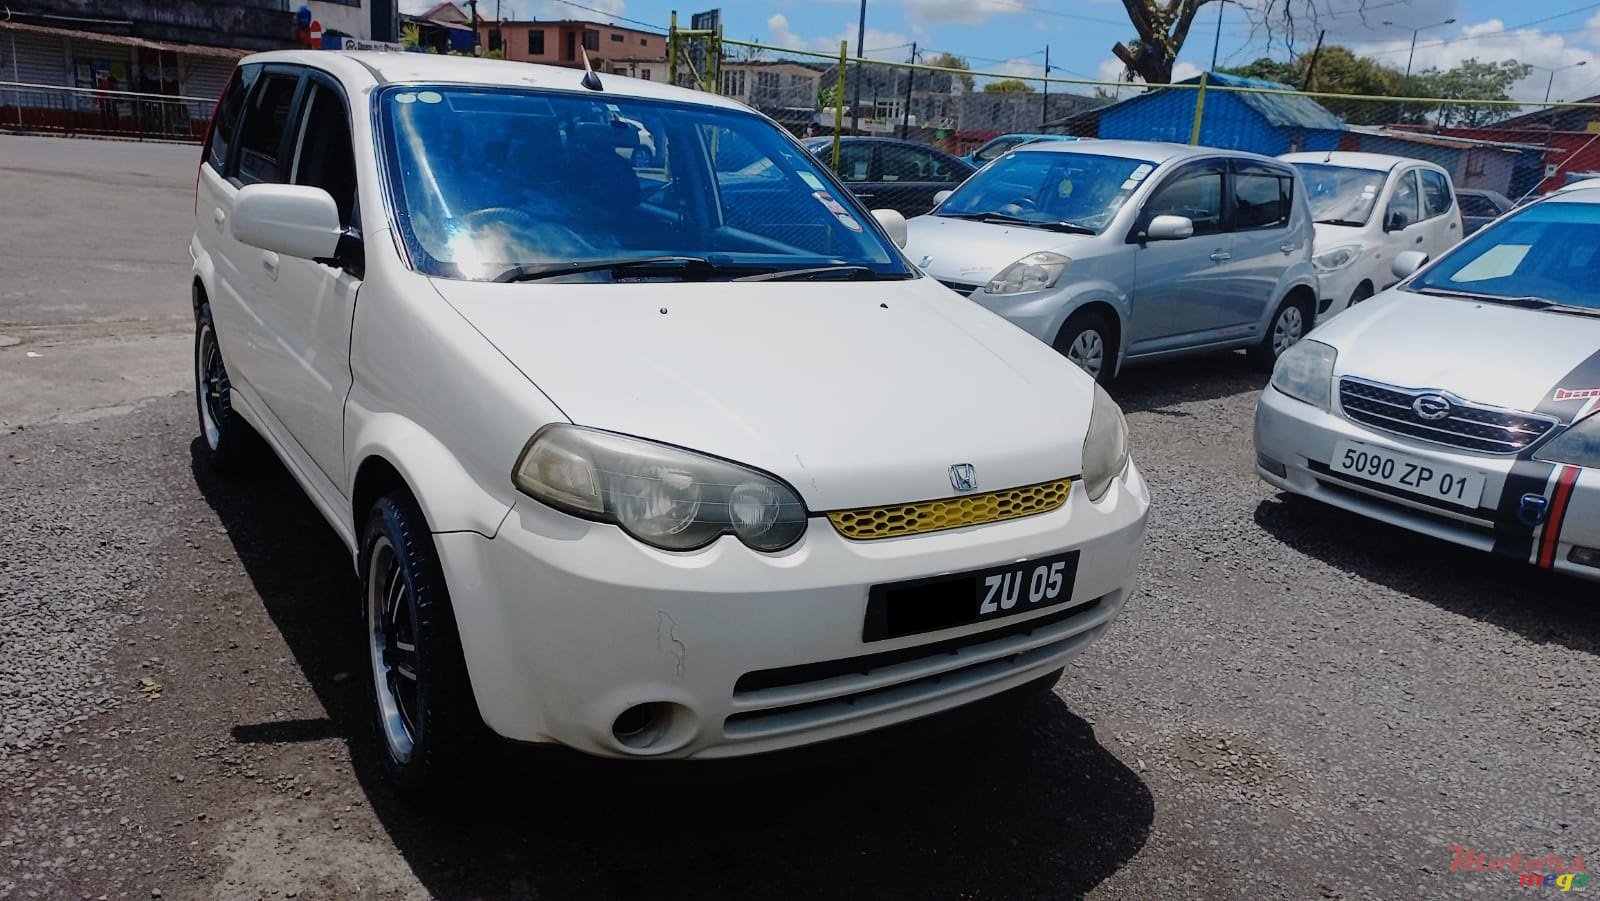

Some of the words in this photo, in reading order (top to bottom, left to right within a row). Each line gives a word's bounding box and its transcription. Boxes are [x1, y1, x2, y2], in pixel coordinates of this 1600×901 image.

[1341, 448, 1396, 479] 5090
[1399, 463, 1434, 489] ZP
[1438, 474, 1467, 500] 01
[979, 570, 1023, 616] ZU
[1029, 561, 1066, 603] 05
